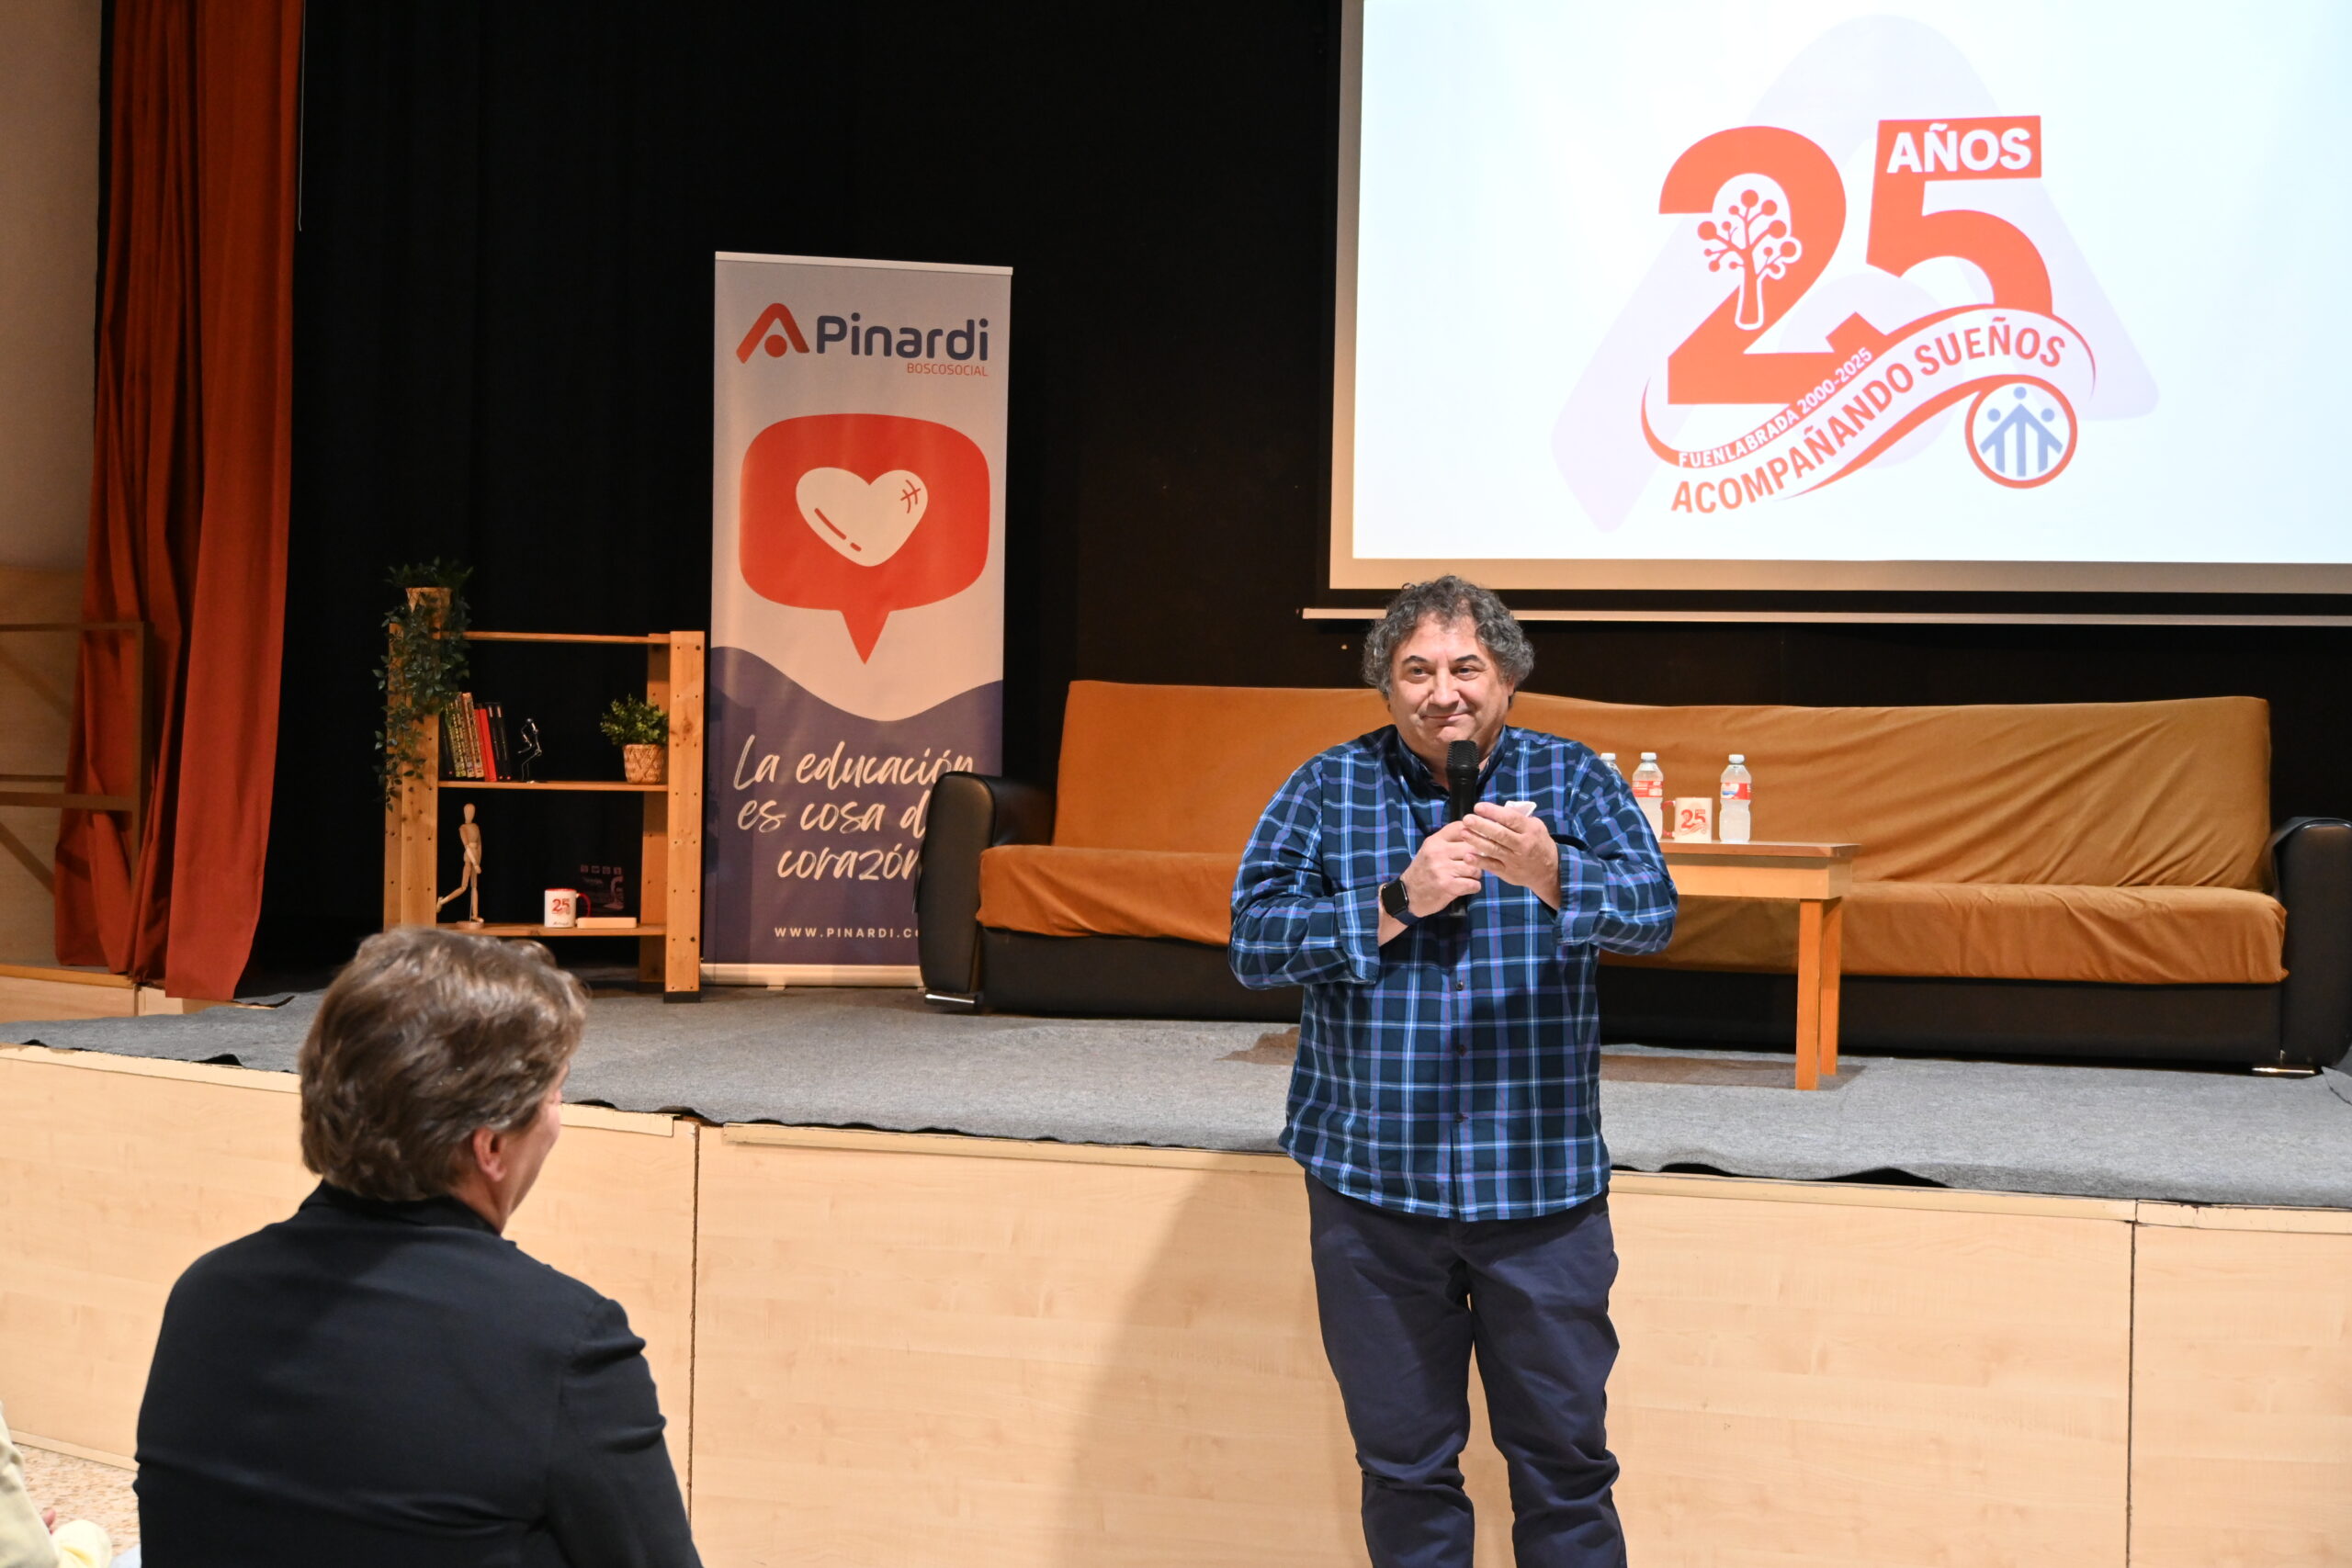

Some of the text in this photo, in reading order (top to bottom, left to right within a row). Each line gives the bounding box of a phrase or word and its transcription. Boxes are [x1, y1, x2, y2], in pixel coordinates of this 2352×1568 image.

[1658, 115, 2053, 404] 25 AÑOS
[816, 312, 989, 361] Pinardi
[906, 362, 989, 377] BOSCOSOCIAL
[1670, 316, 2066, 514] ACOMPAÑANDO SUEÑOS
[1678, 346, 1873, 468] FUENLABRADA 2000-2025
[732, 734, 781, 791] La
[737, 790, 931, 839] es cosa d
[1680, 808, 1706, 829] 25
